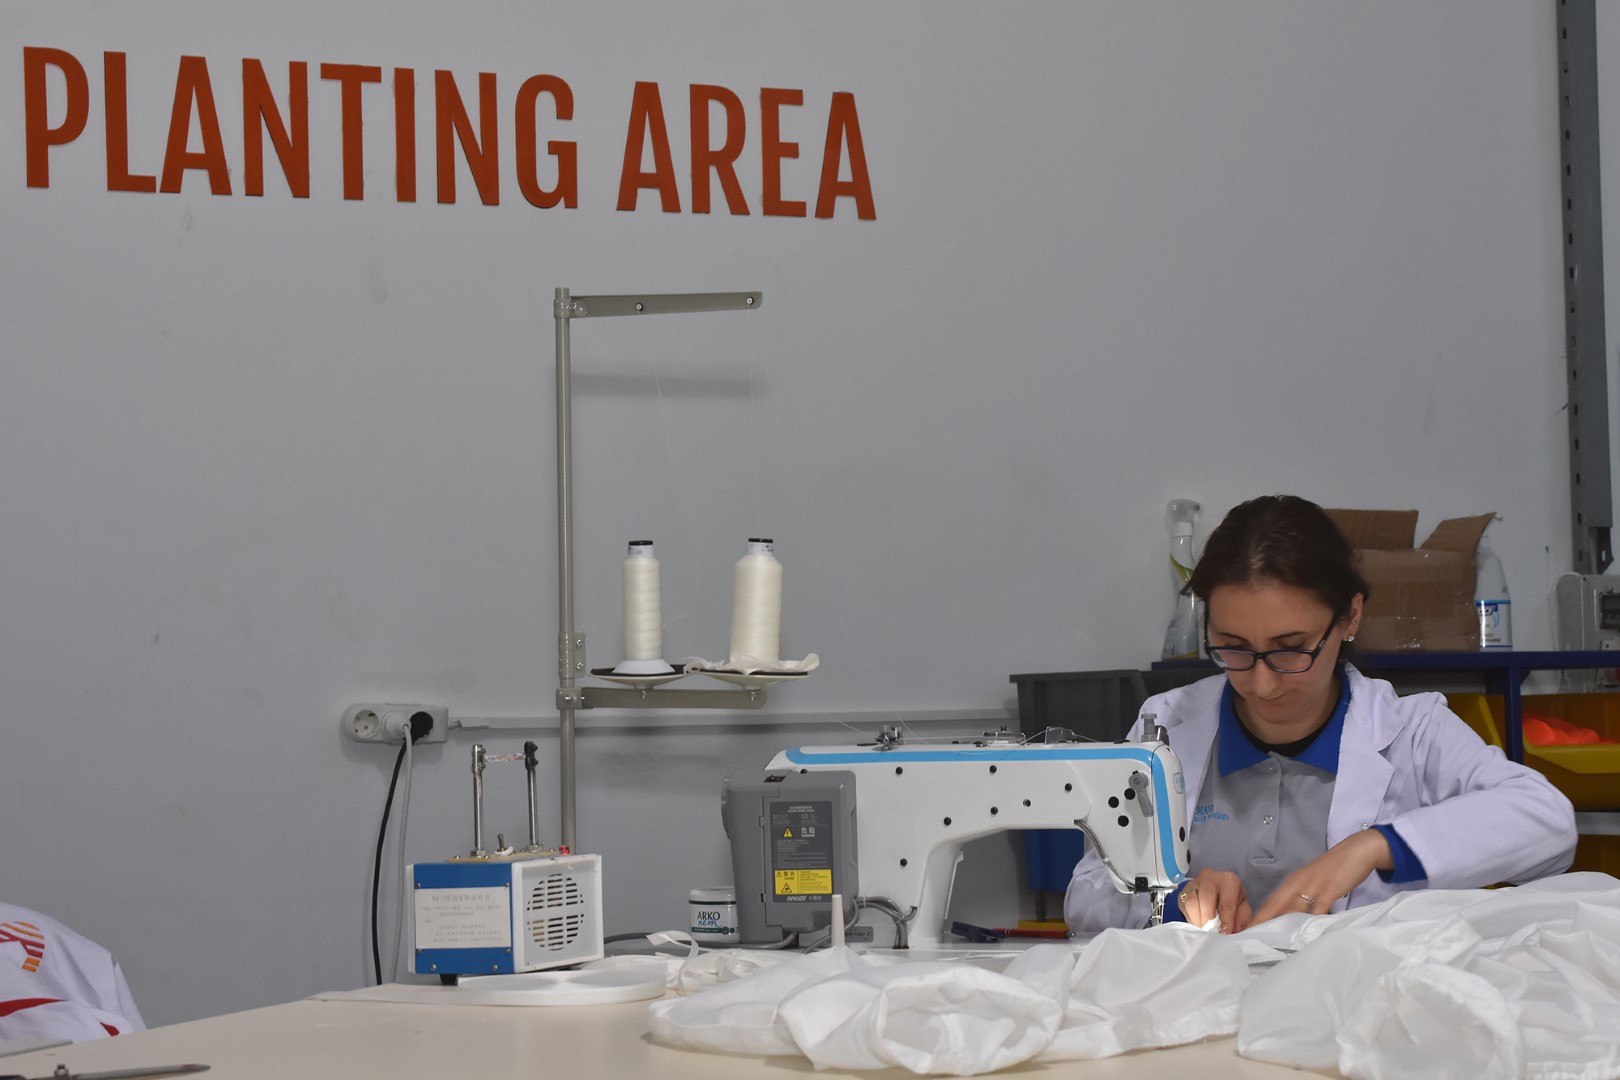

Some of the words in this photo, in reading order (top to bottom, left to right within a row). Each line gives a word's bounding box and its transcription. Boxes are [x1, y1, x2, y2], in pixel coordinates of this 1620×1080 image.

[23, 46, 578, 210] PLANTING
[616, 81, 877, 220] AREA
[697, 911, 721, 921] ARKO
